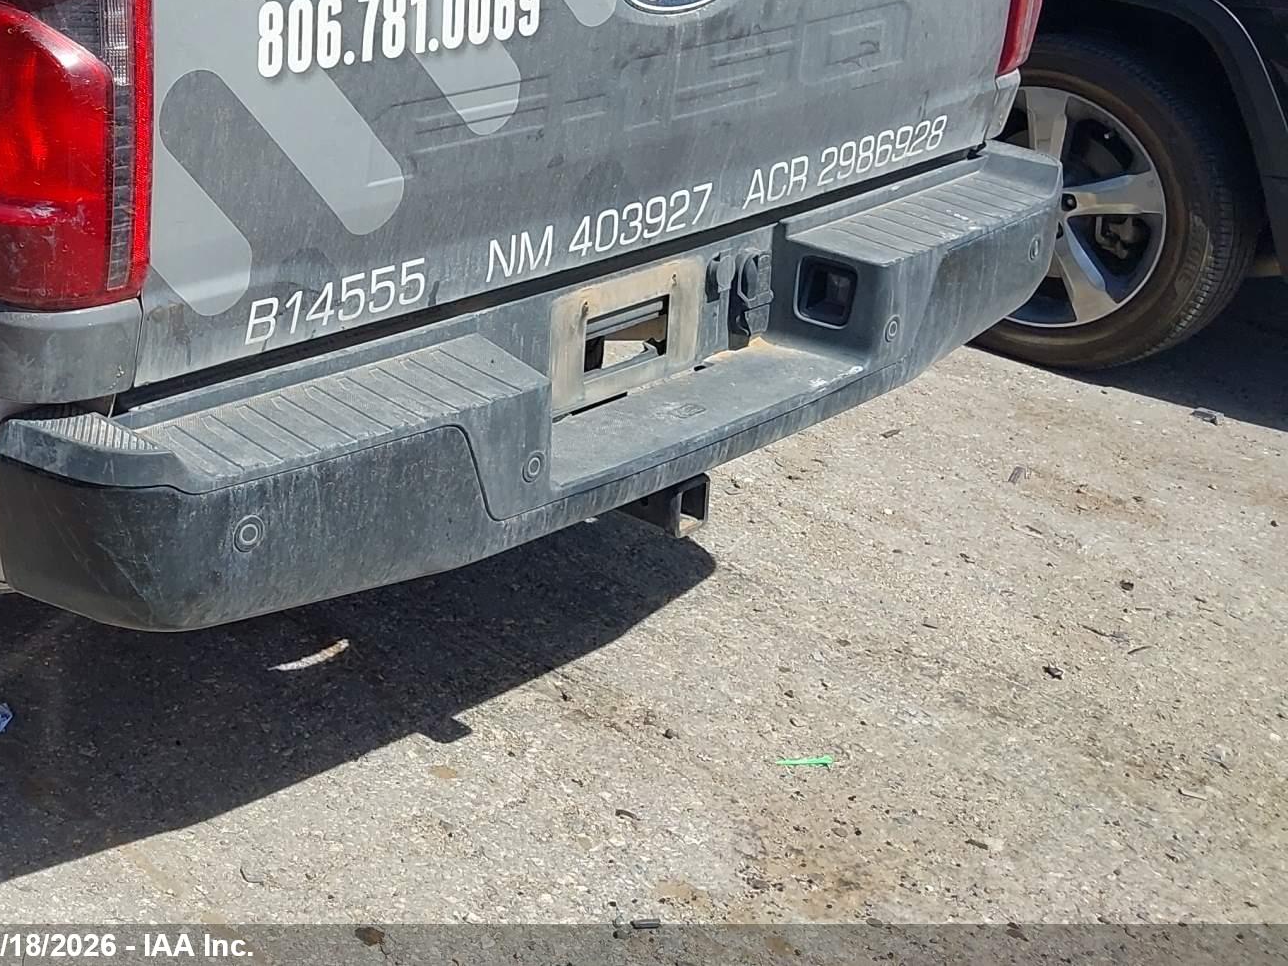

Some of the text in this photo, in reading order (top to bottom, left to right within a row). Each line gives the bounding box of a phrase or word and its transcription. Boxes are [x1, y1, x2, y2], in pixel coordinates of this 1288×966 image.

[245, 115, 948, 345] B14555 NM 403927 ACR 2986928
